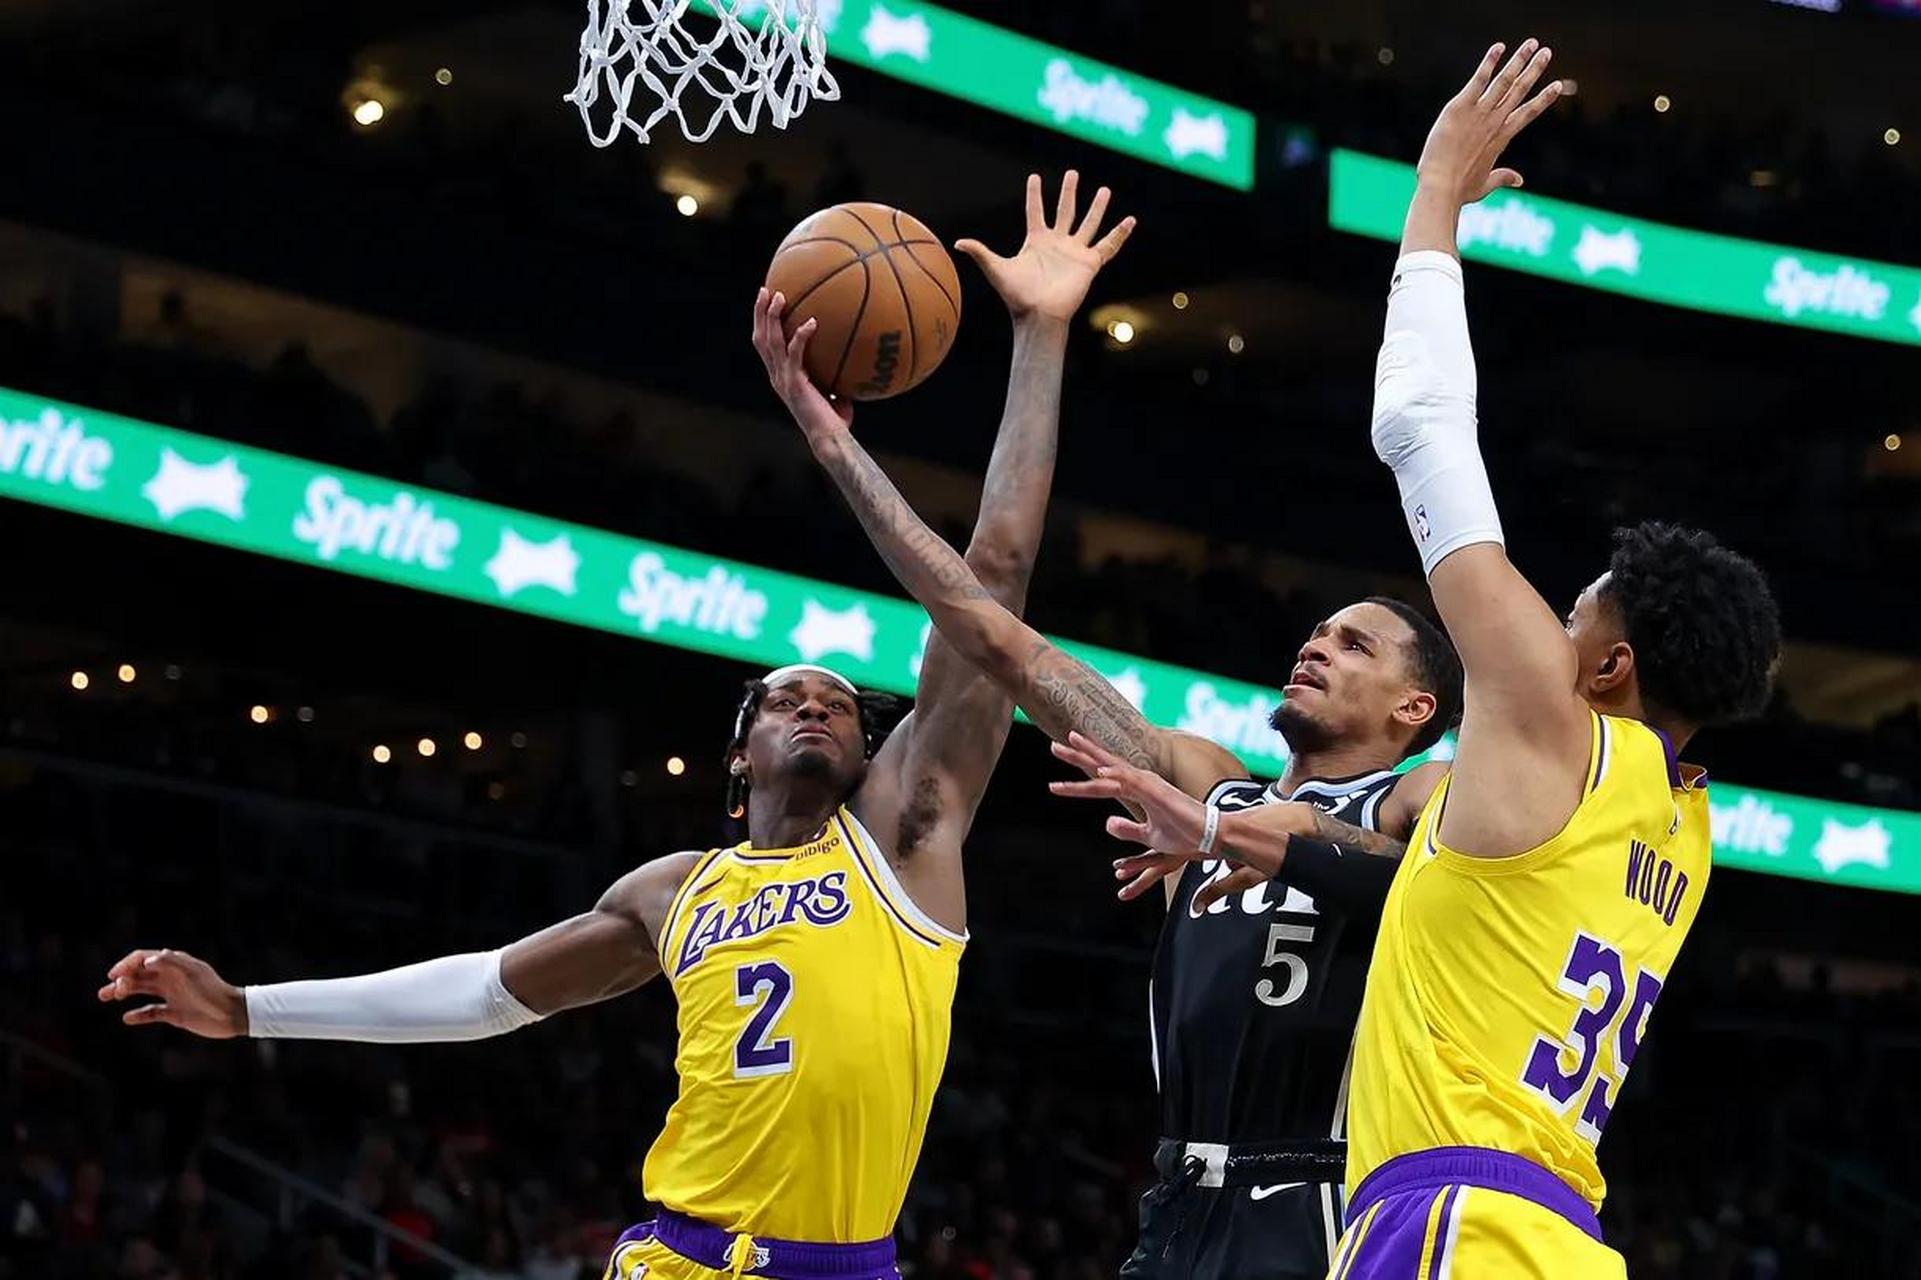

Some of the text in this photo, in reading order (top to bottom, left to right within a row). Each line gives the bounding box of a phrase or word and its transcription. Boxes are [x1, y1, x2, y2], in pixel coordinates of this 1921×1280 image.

[292, 475, 460, 570] Sprite
[617, 551, 769, 641] Sprite
[674, 871, 851, 979] LAKERS
[1624, 838, 1689, 927] WOOD
[1254, 922, 1315, 1007] 5
[733, 958, 796, 1080] 2
